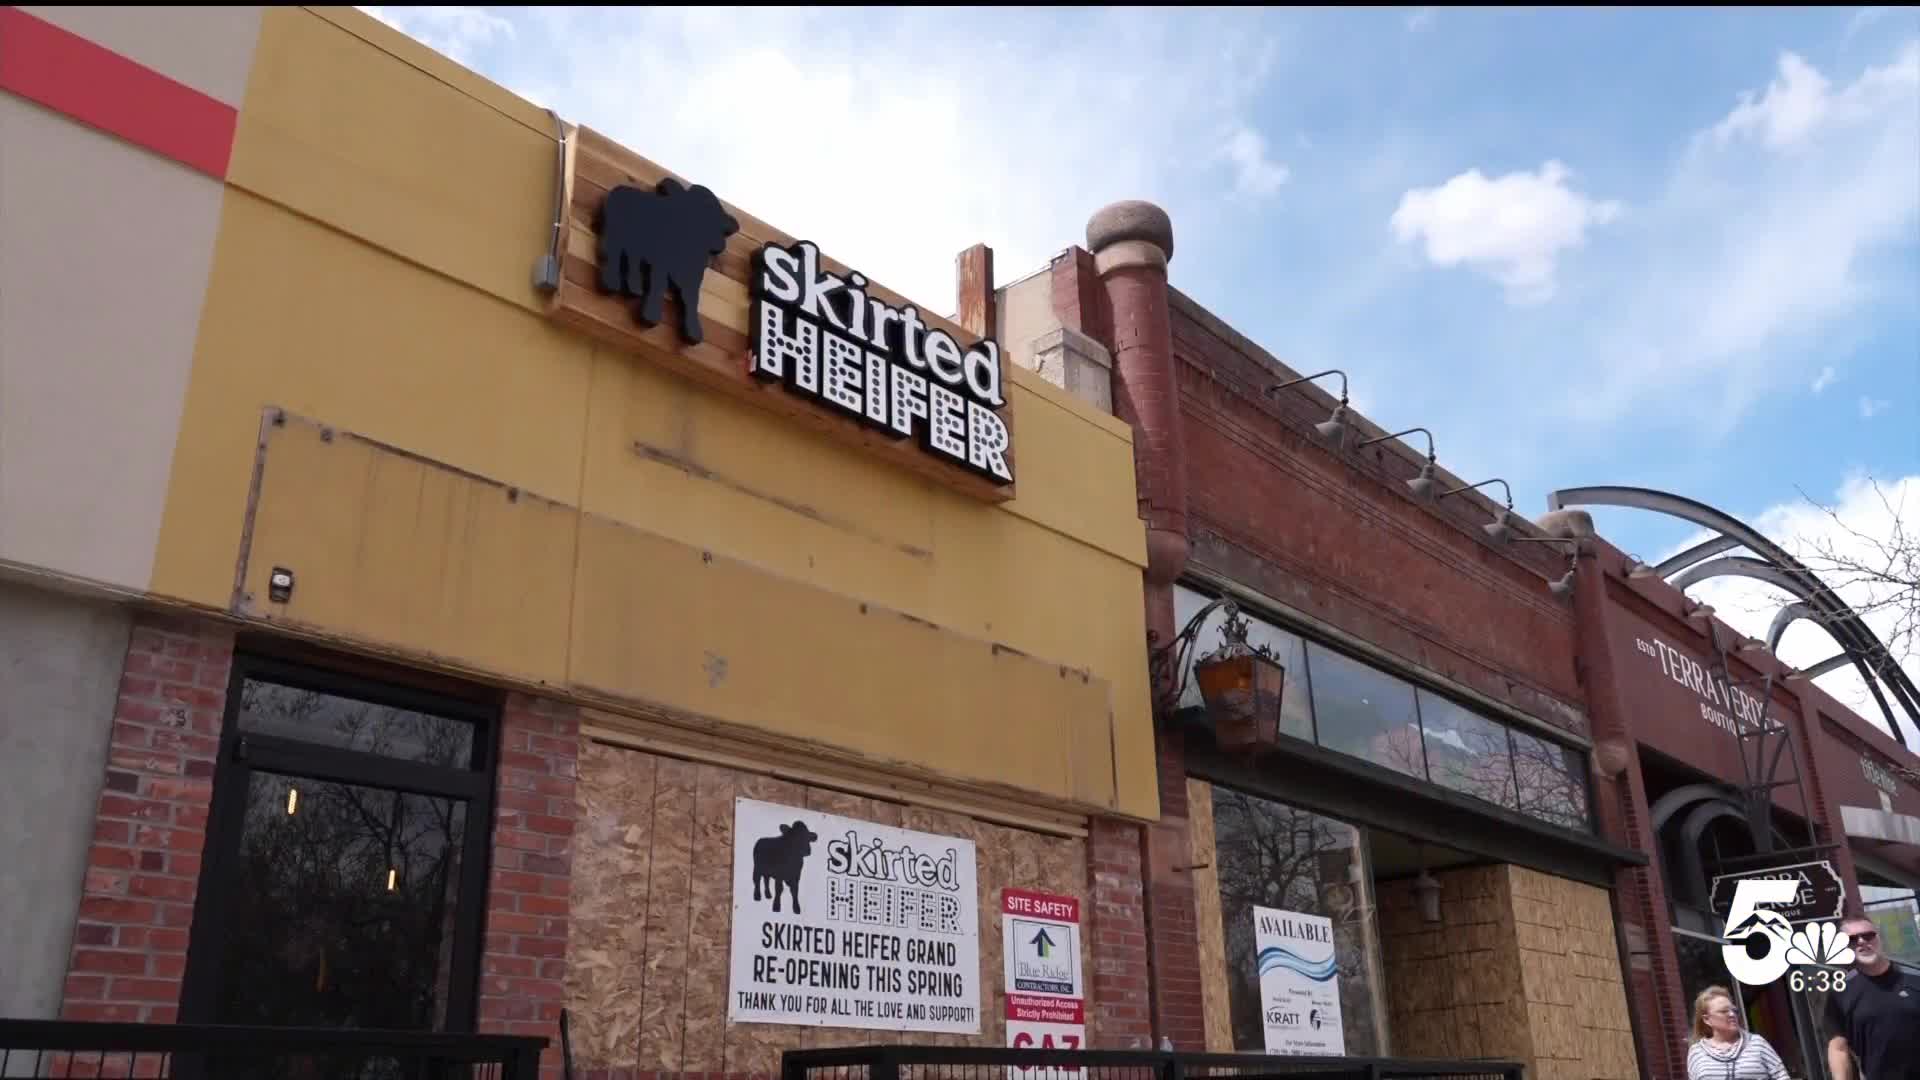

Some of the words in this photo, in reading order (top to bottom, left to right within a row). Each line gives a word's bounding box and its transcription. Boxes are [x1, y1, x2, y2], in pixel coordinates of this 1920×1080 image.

[762, 241, 1006, 407] skirted
[760, 299, 1013, 482] HEIFER
[1653, 638, 1720, 706] TERRA
[827, 830, 960, 892] skirted
[826, 876, 964, 936] HEIFER
[1007, 895, 1032, 912] SITE
[1034, 899, 1073, 918] SAFETY
[761, 921, 836, 956] SKIRTED
[842, 930, 900, 963] HEIFER
[906, 938, 957, 968] GRAND
[1259, 916, 1331, 944] AVAILABLE
[753, 954, 861, 991] RE-OPENING
[866, 965, 902, 994] THIS
[907, 969, 963, 998] SPRING
[1017, 961, 1040, 977] Blue
[738, 991, 776, 1011] THANK
[780, 994, 802, 1013] YOU
[806, 995, 827, 1014] FOR
[831, 998, 851, 1016] ALL
[854, 1000, 874, 1017] THE
[877, 1001, 904, 1019] LOVE
[906, 1003, 926, 1020] AND
[929, 1005, 975, 1024] SUPPORT!
[1011, 995, 1055, 1008] Unauthorized
[1055, 999, 1079, 1009] Access
[1016, 1007, 1040, 1021] Strictly
[1041, 1009, 1075, 1021] Prohibited
[1266, 1011, 1301, 1025] KRATT
